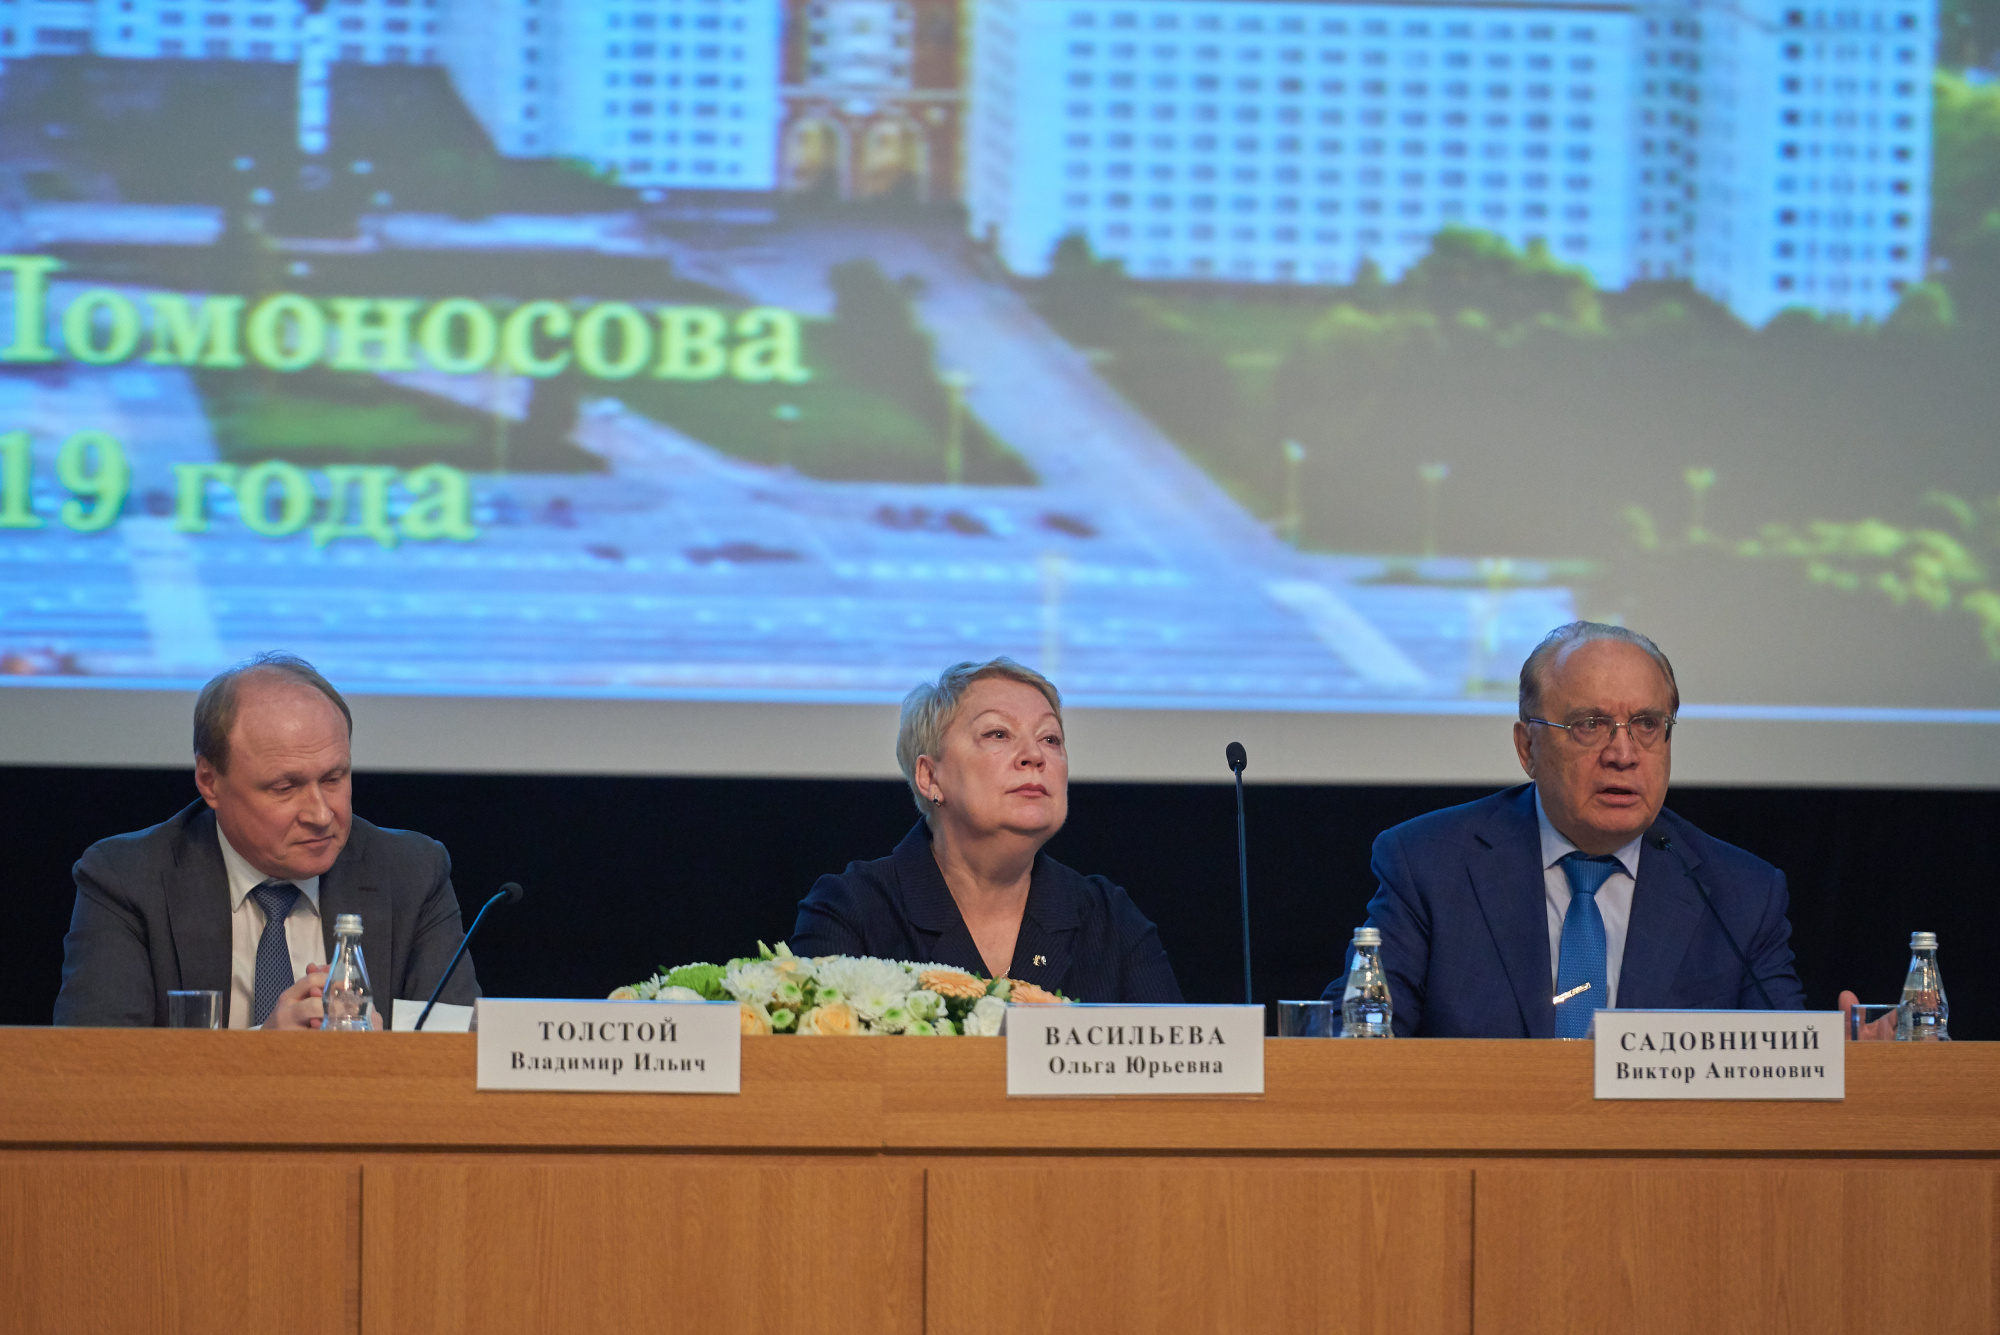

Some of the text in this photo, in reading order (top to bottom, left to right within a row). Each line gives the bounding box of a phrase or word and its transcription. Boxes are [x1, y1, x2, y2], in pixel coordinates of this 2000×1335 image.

[174, 460, 476, 548] года
[539, 1017, 677, 1043] ТОЛСТОЙ
[1045, 1026, 1226, 1046] ВАСИЛЬЕВА
[1620, 1025, 1820, 1054] САДОВНИЧИЙ
[512, 1052, 706, 1075] Владимир Ильич
[1049, 1055, 1223, 1078] Ольга Юрьевна
[1617, 1061, 1825, 1083] Виктор Антонович
